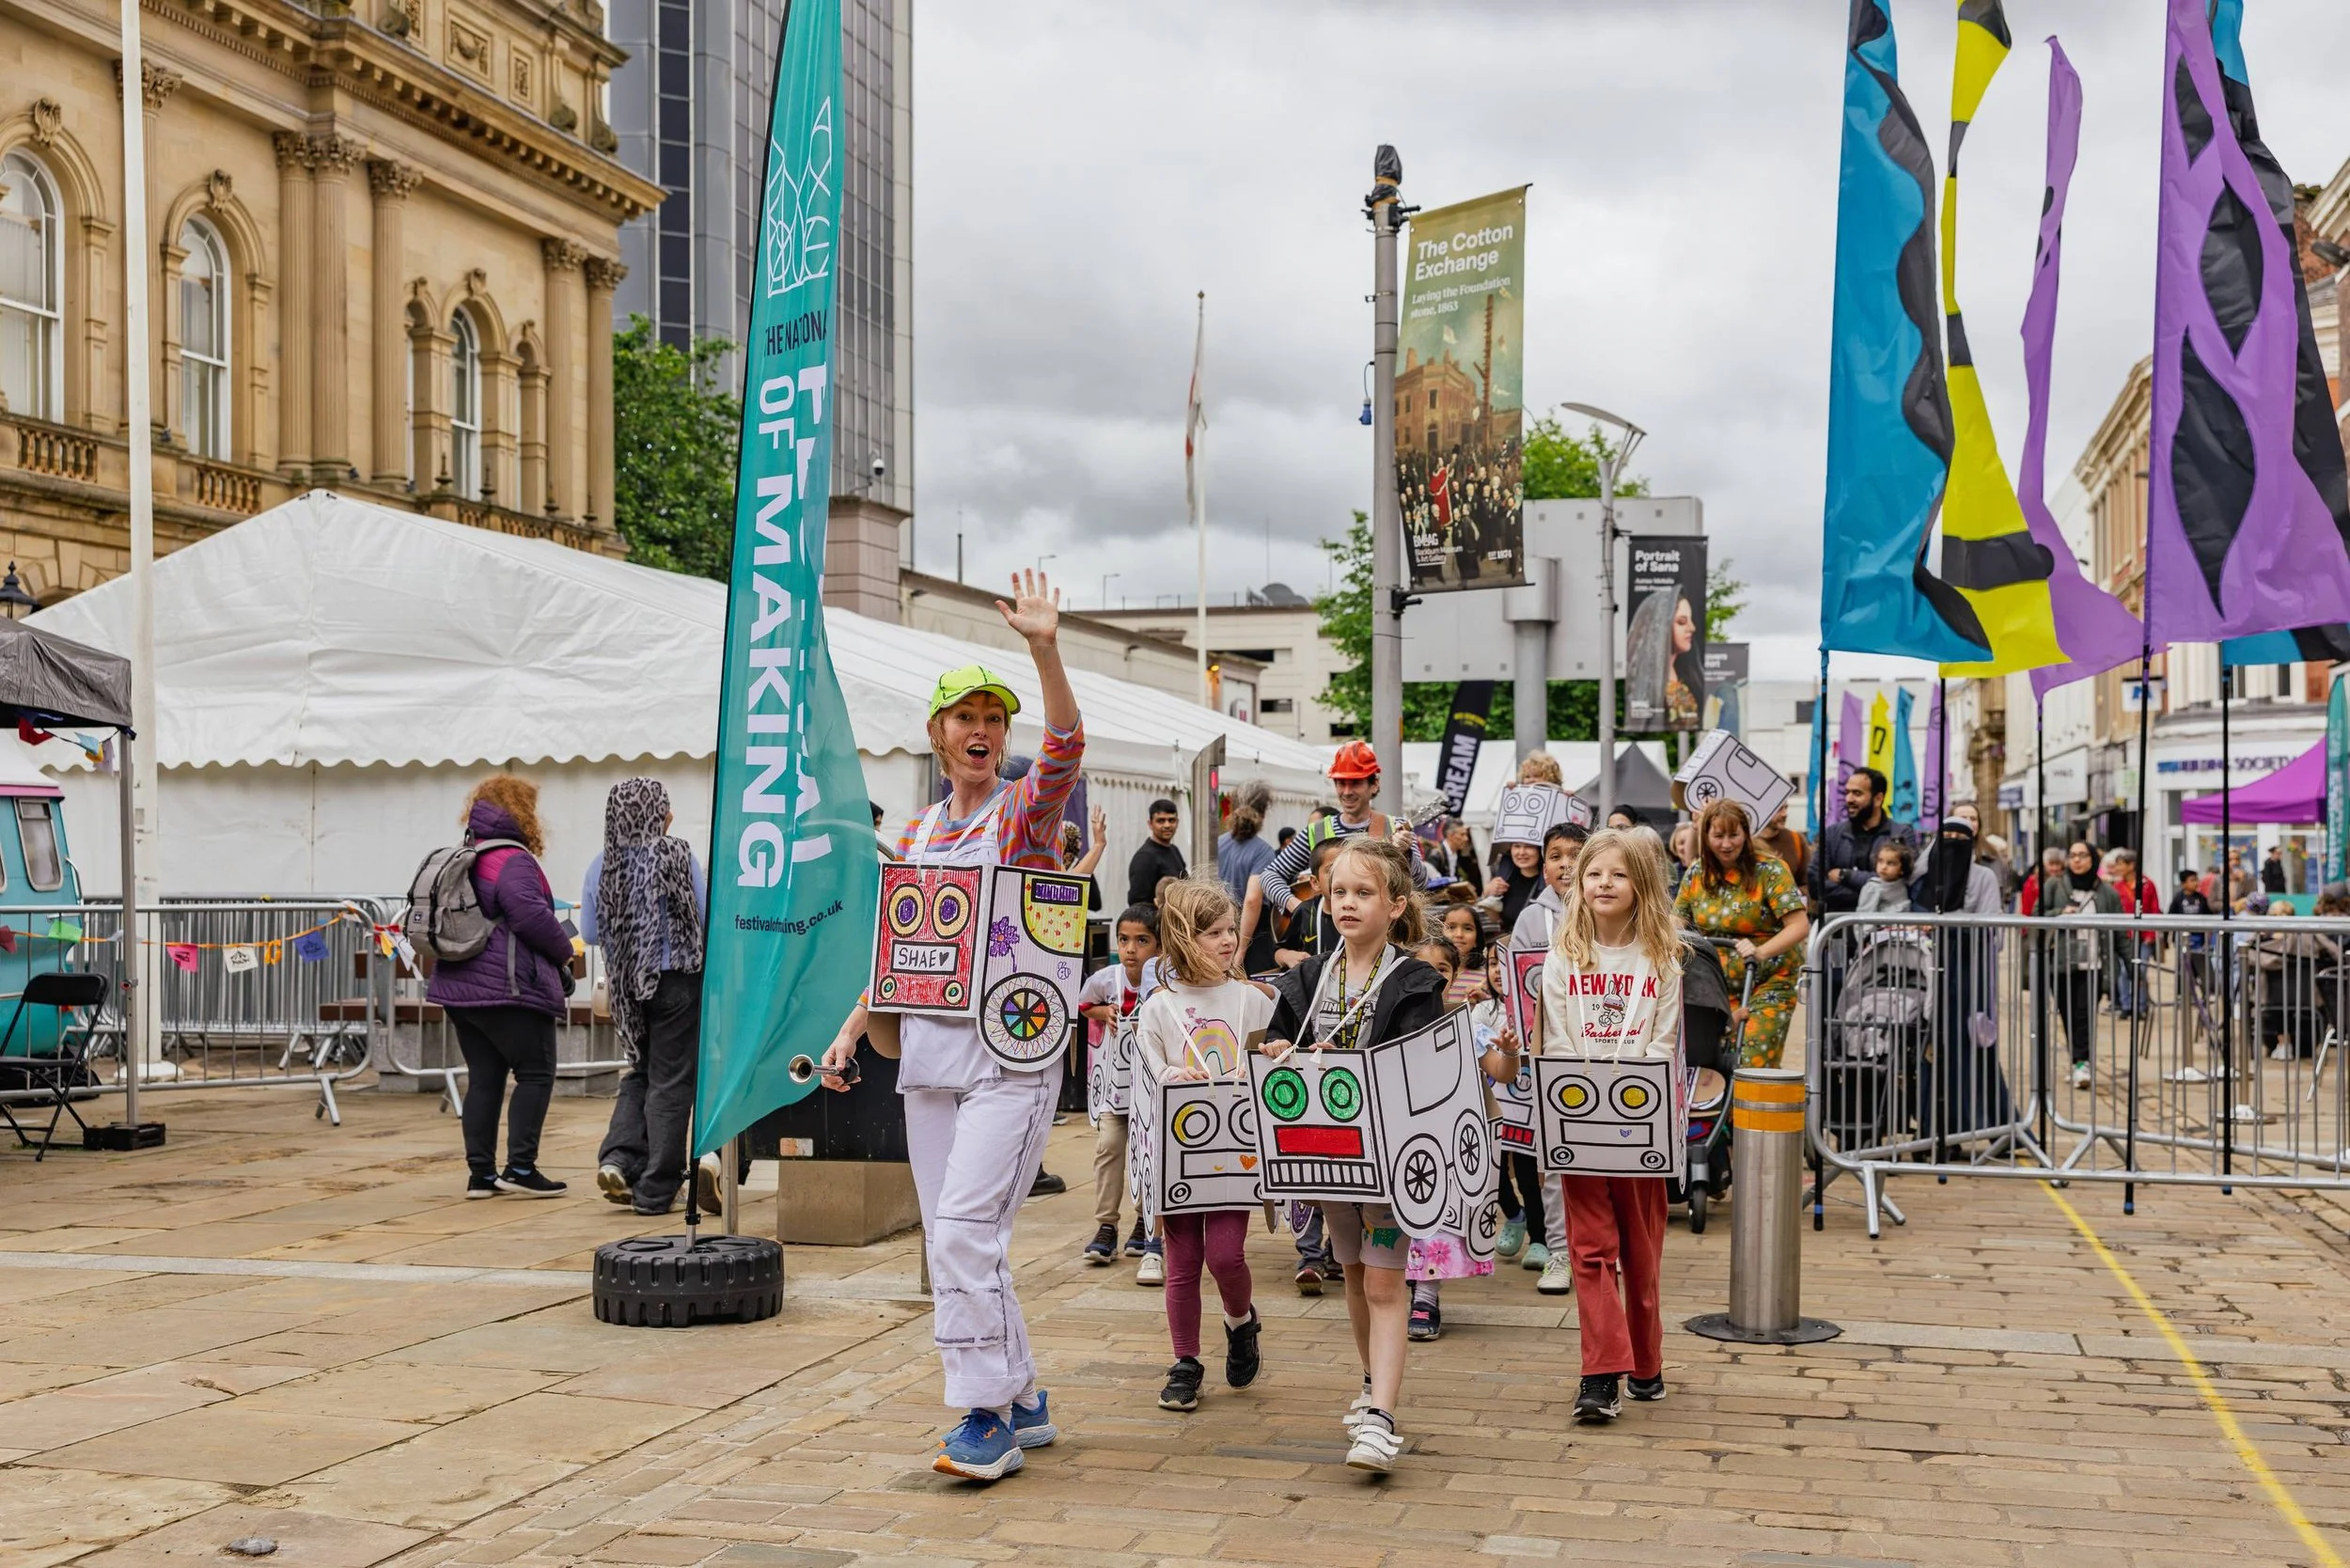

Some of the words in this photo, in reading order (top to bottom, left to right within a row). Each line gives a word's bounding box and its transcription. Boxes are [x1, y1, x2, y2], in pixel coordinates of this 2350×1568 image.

[1417, 239, 1449, 260] The
[1451, 225, 1513, 251] Cotton
[1415, 249, 1499, 281] Exchange
[1412, 290, 1441, 305] Laying
[1442, 287, 1459, 298] the
[1459, 276, 1512, 295] Foundation
[1437, 301, 1459, 314] 1863
[759, 375, 795, 450] OF
[1635, 549, 1681, 562] Portrait
[1635, 561, 1649, 572] of
[1650, 561, 1680, 572] Sana
[737, 473, 792, 888] MAKING
[898, 947, 937, 969] SHAE
[1569, 974, 1607, 996] NEW
